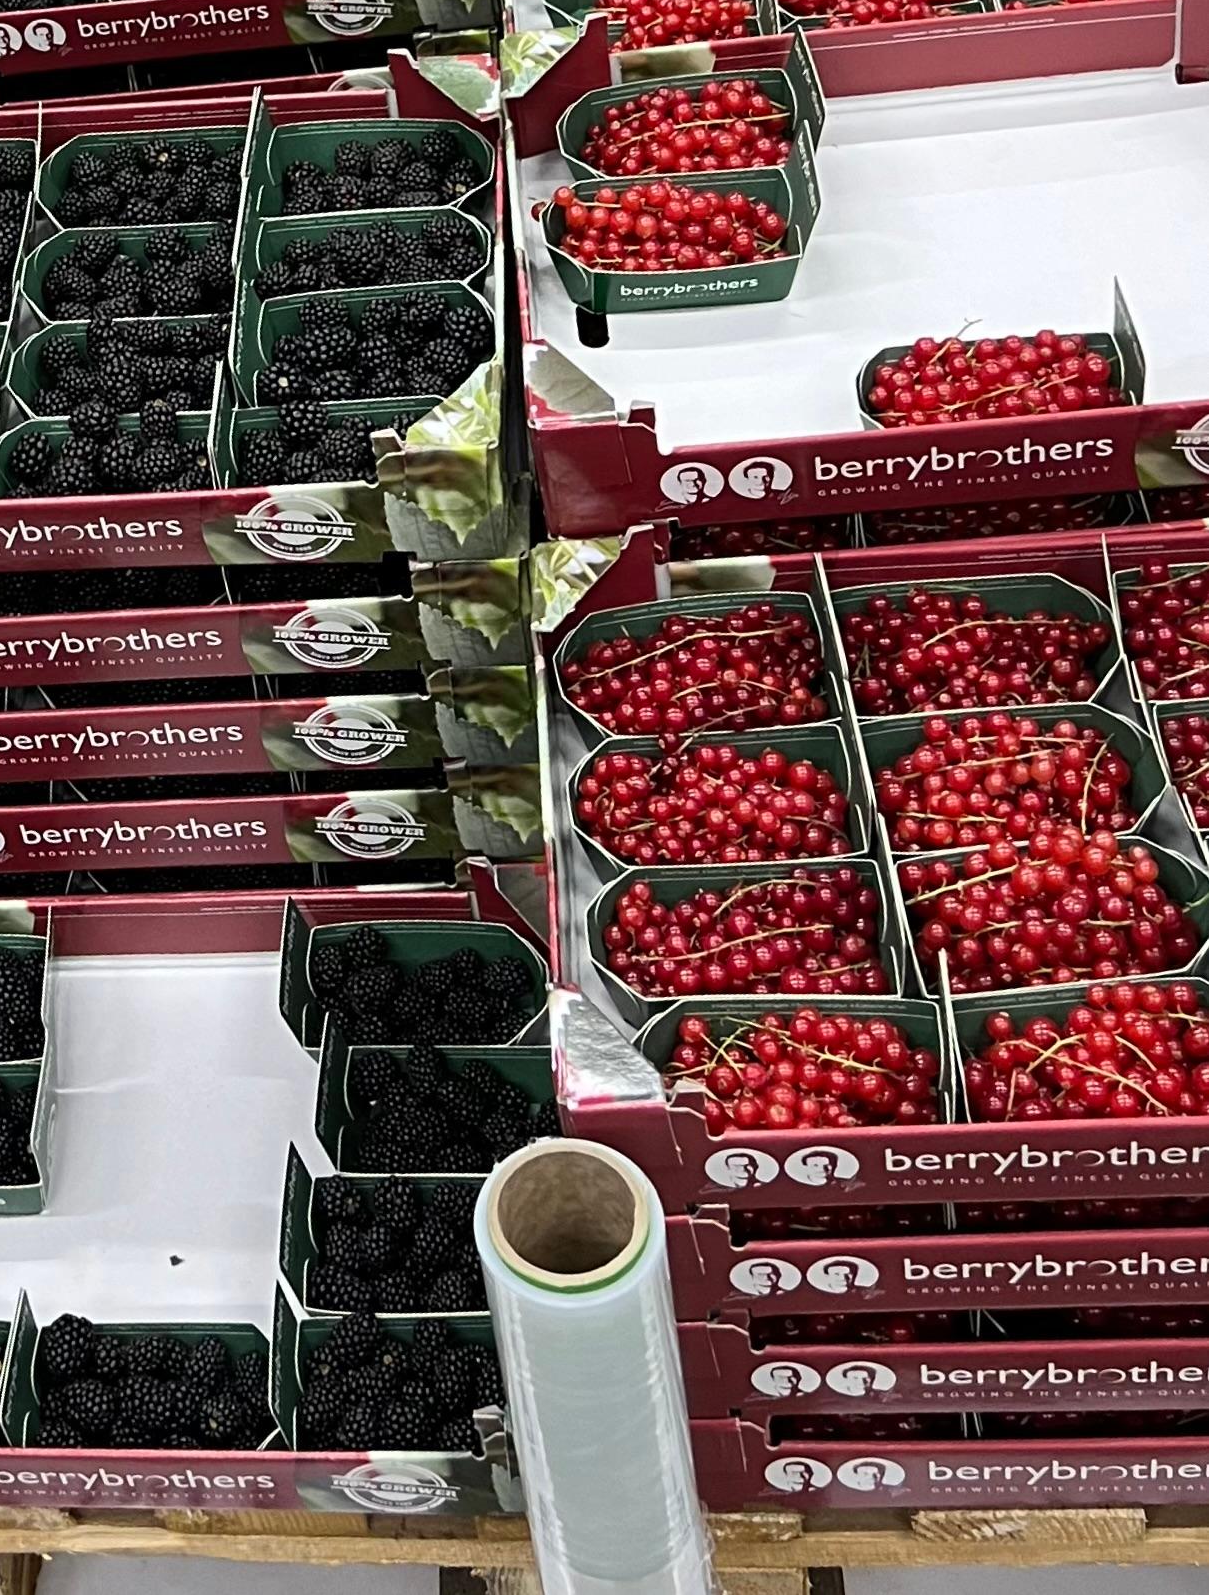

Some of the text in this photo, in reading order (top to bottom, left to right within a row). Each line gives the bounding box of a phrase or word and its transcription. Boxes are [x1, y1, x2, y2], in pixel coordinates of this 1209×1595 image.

[77, 5, 269, 37] berrybrothers
[620, 278, 759, 296] berrybrothers
[814, 436, 1114, 481] berrybrothers
[915, 480, 945, 490] THE
[235, 520, 354, 537] 100% GROWER
[12, 549, 39, 557] THE
[274, 631, 389, 646] 100% GROWER
[54, 660, 81, 668] THE
[294, 727, 407, 743] 100% GROWER
[19, 818, 266, 847] berrybrothers
[315, 821, 425, 837] 100% GROWER
[1000, 1175, 1036, 1185] THE
[1016, 1284, 1050, 1293] THE
[920, 1361, 1209, 1390] berrybrothe
[928, 1458, 1209, 1486] berrybrothe
